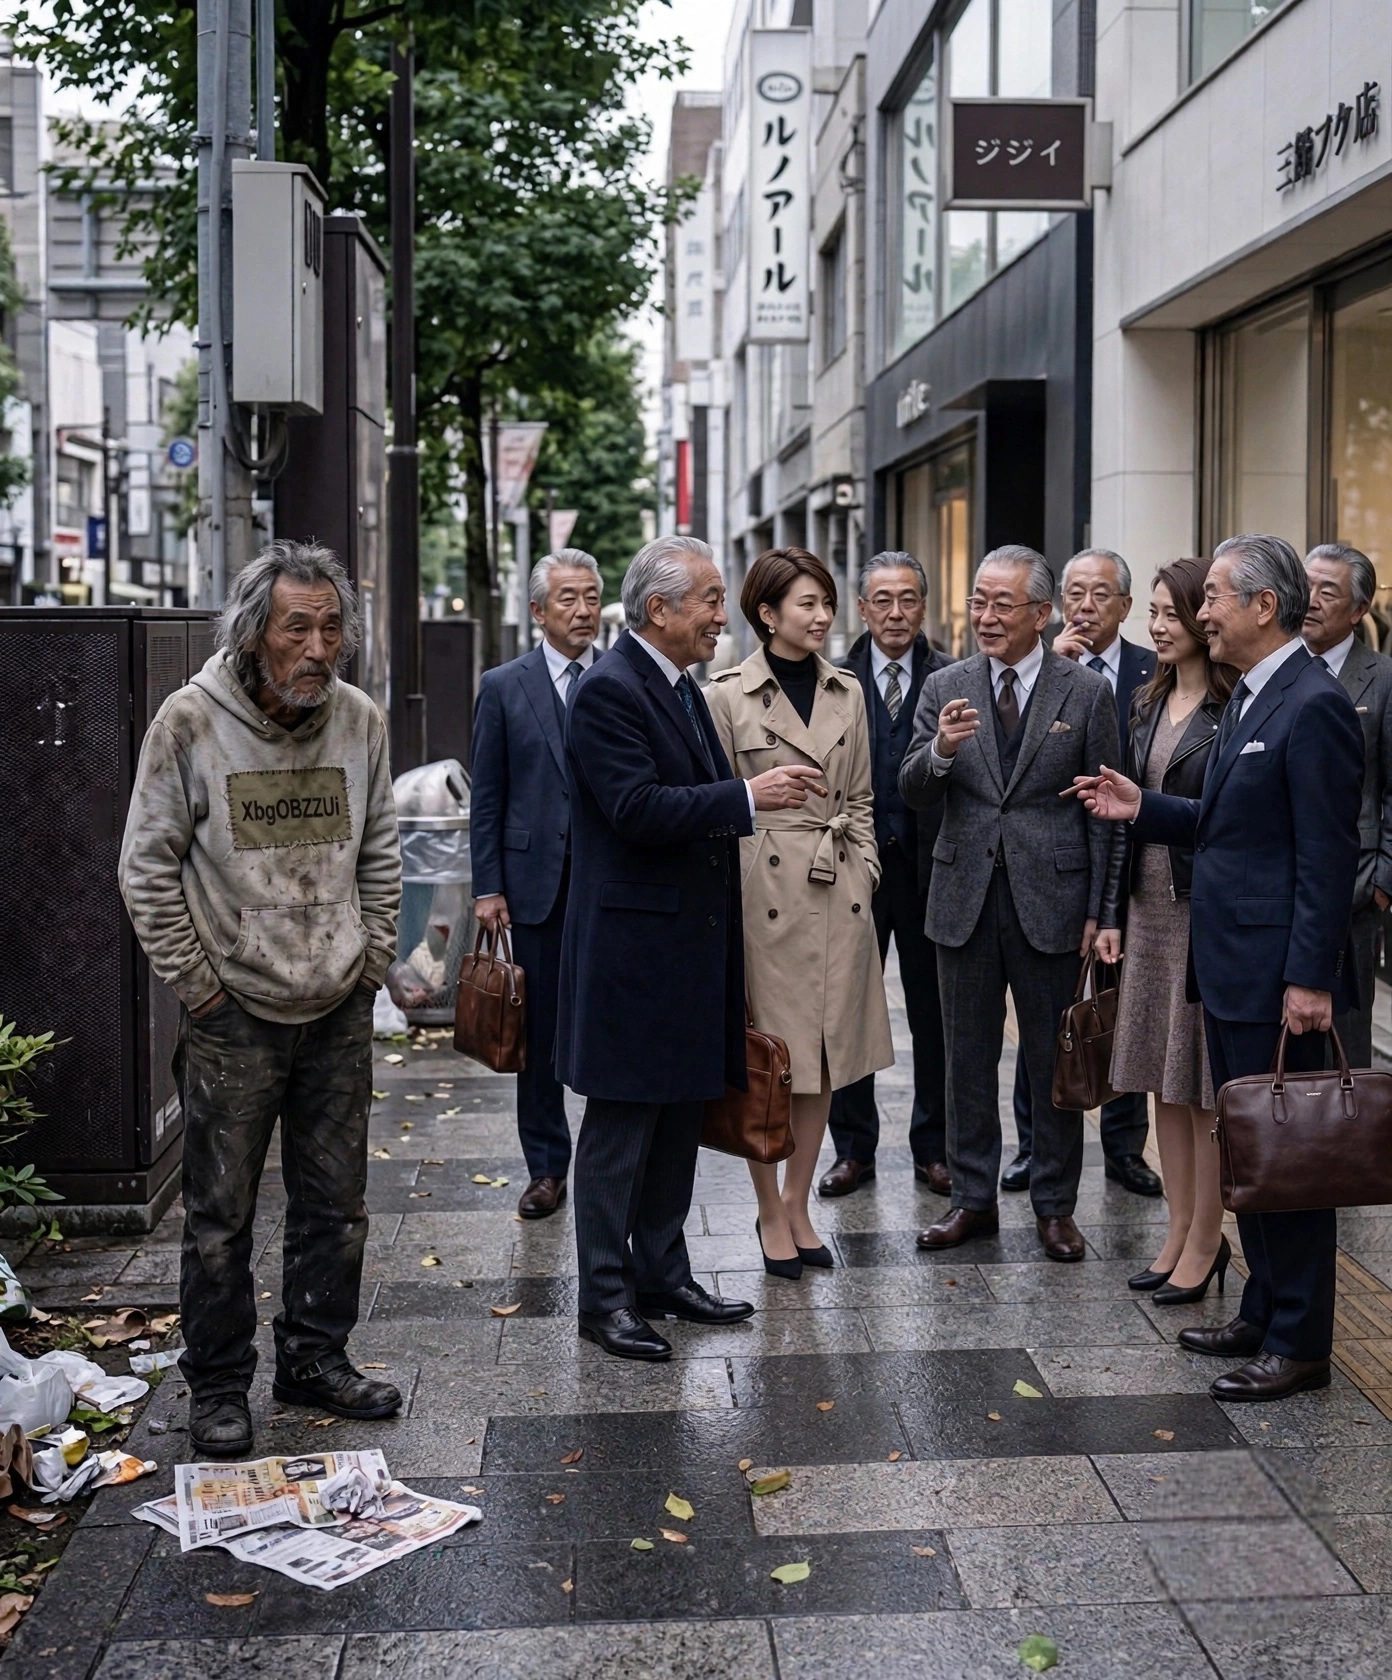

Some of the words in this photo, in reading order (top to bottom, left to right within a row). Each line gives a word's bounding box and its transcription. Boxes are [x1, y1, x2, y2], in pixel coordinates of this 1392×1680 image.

[975, 138, 1061, 166] ジジイ
[761, 115, 798, 293] ルノアール
